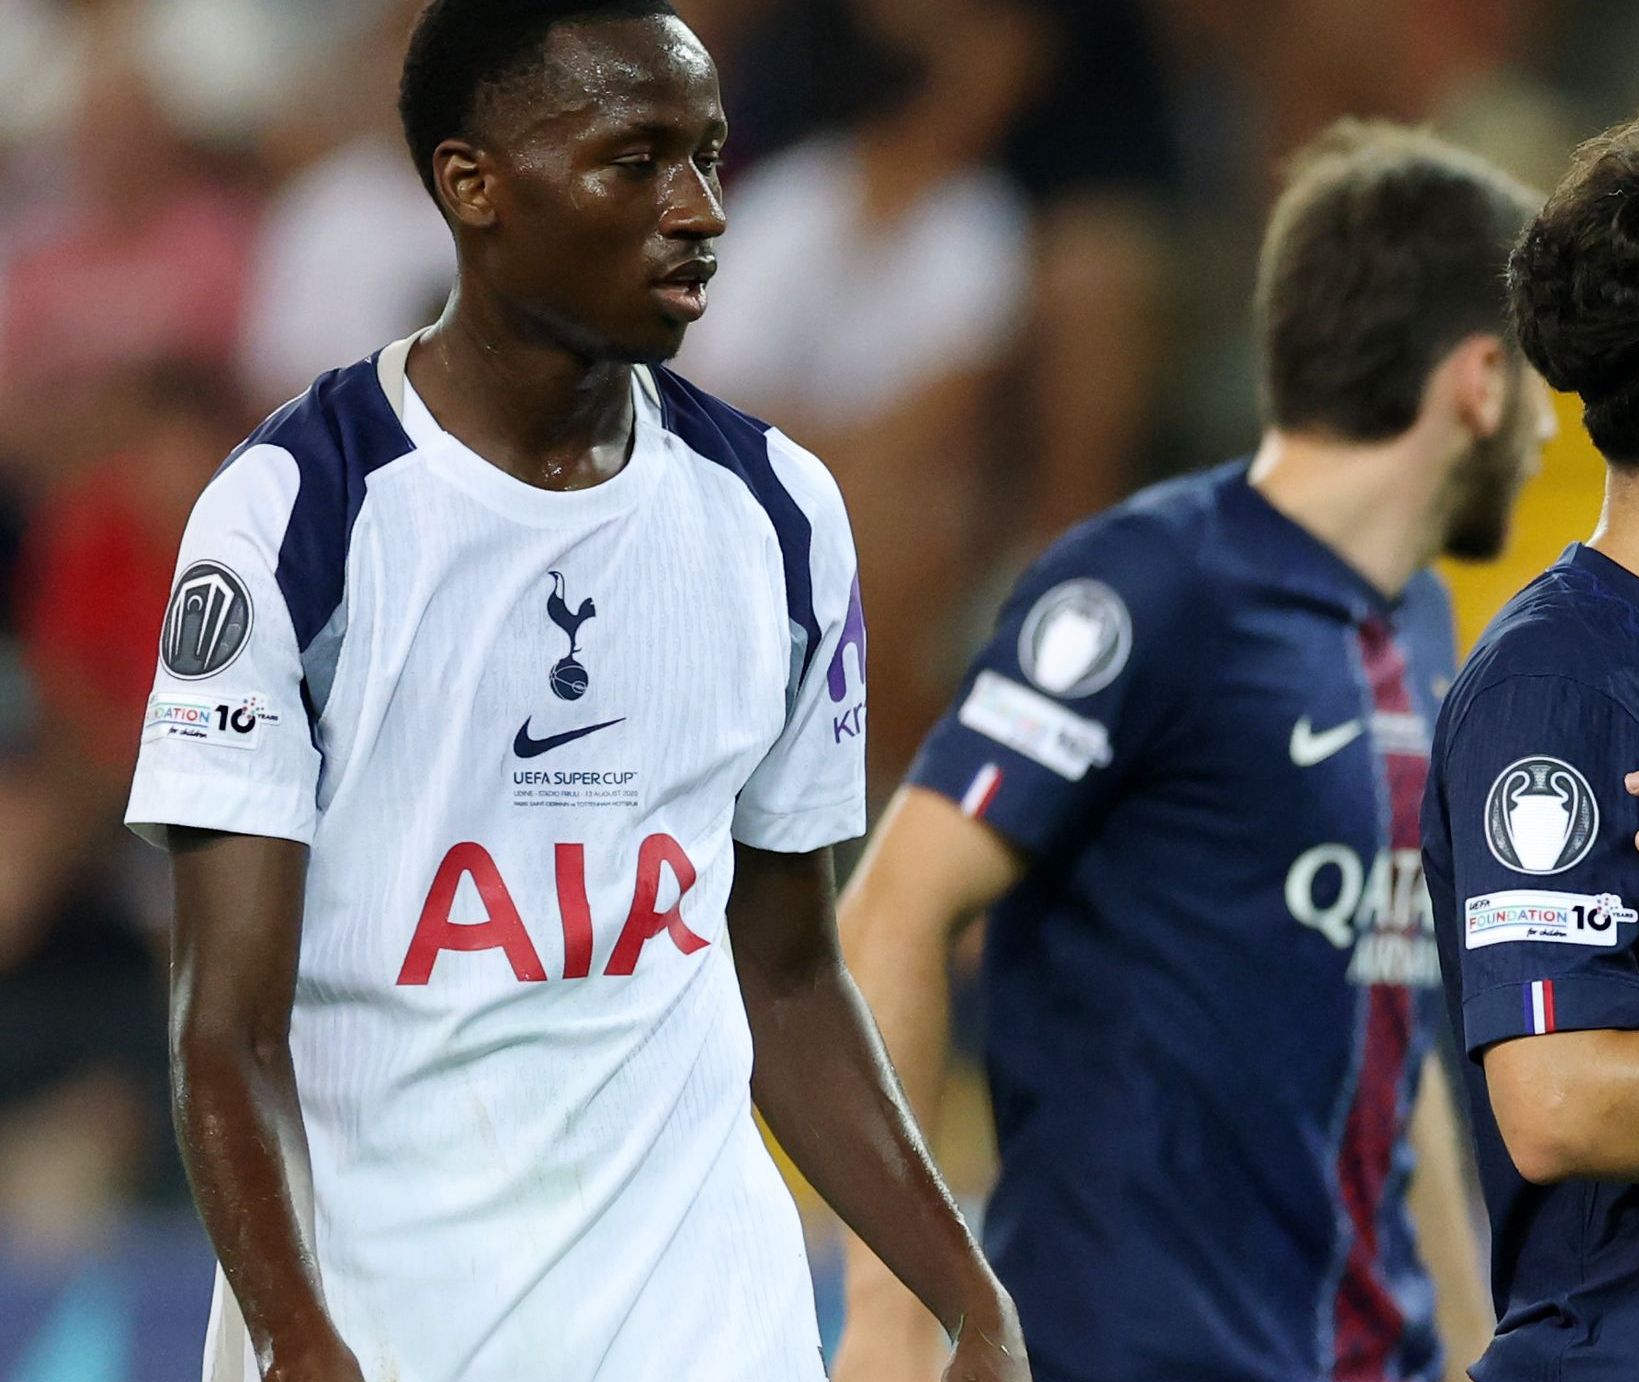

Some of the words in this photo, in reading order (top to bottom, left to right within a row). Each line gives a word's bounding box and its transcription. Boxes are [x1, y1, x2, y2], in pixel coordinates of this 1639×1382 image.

[215, 703, 256, 734] 10
[513, 771, 550, 785] UEFA
[554, 771, 601, 785] SUPER
[395, 832, 711, 986] AIA
[1469, 909, 1568, 930] FOUNDATION
[1571, 905, 1612, 932] 10
